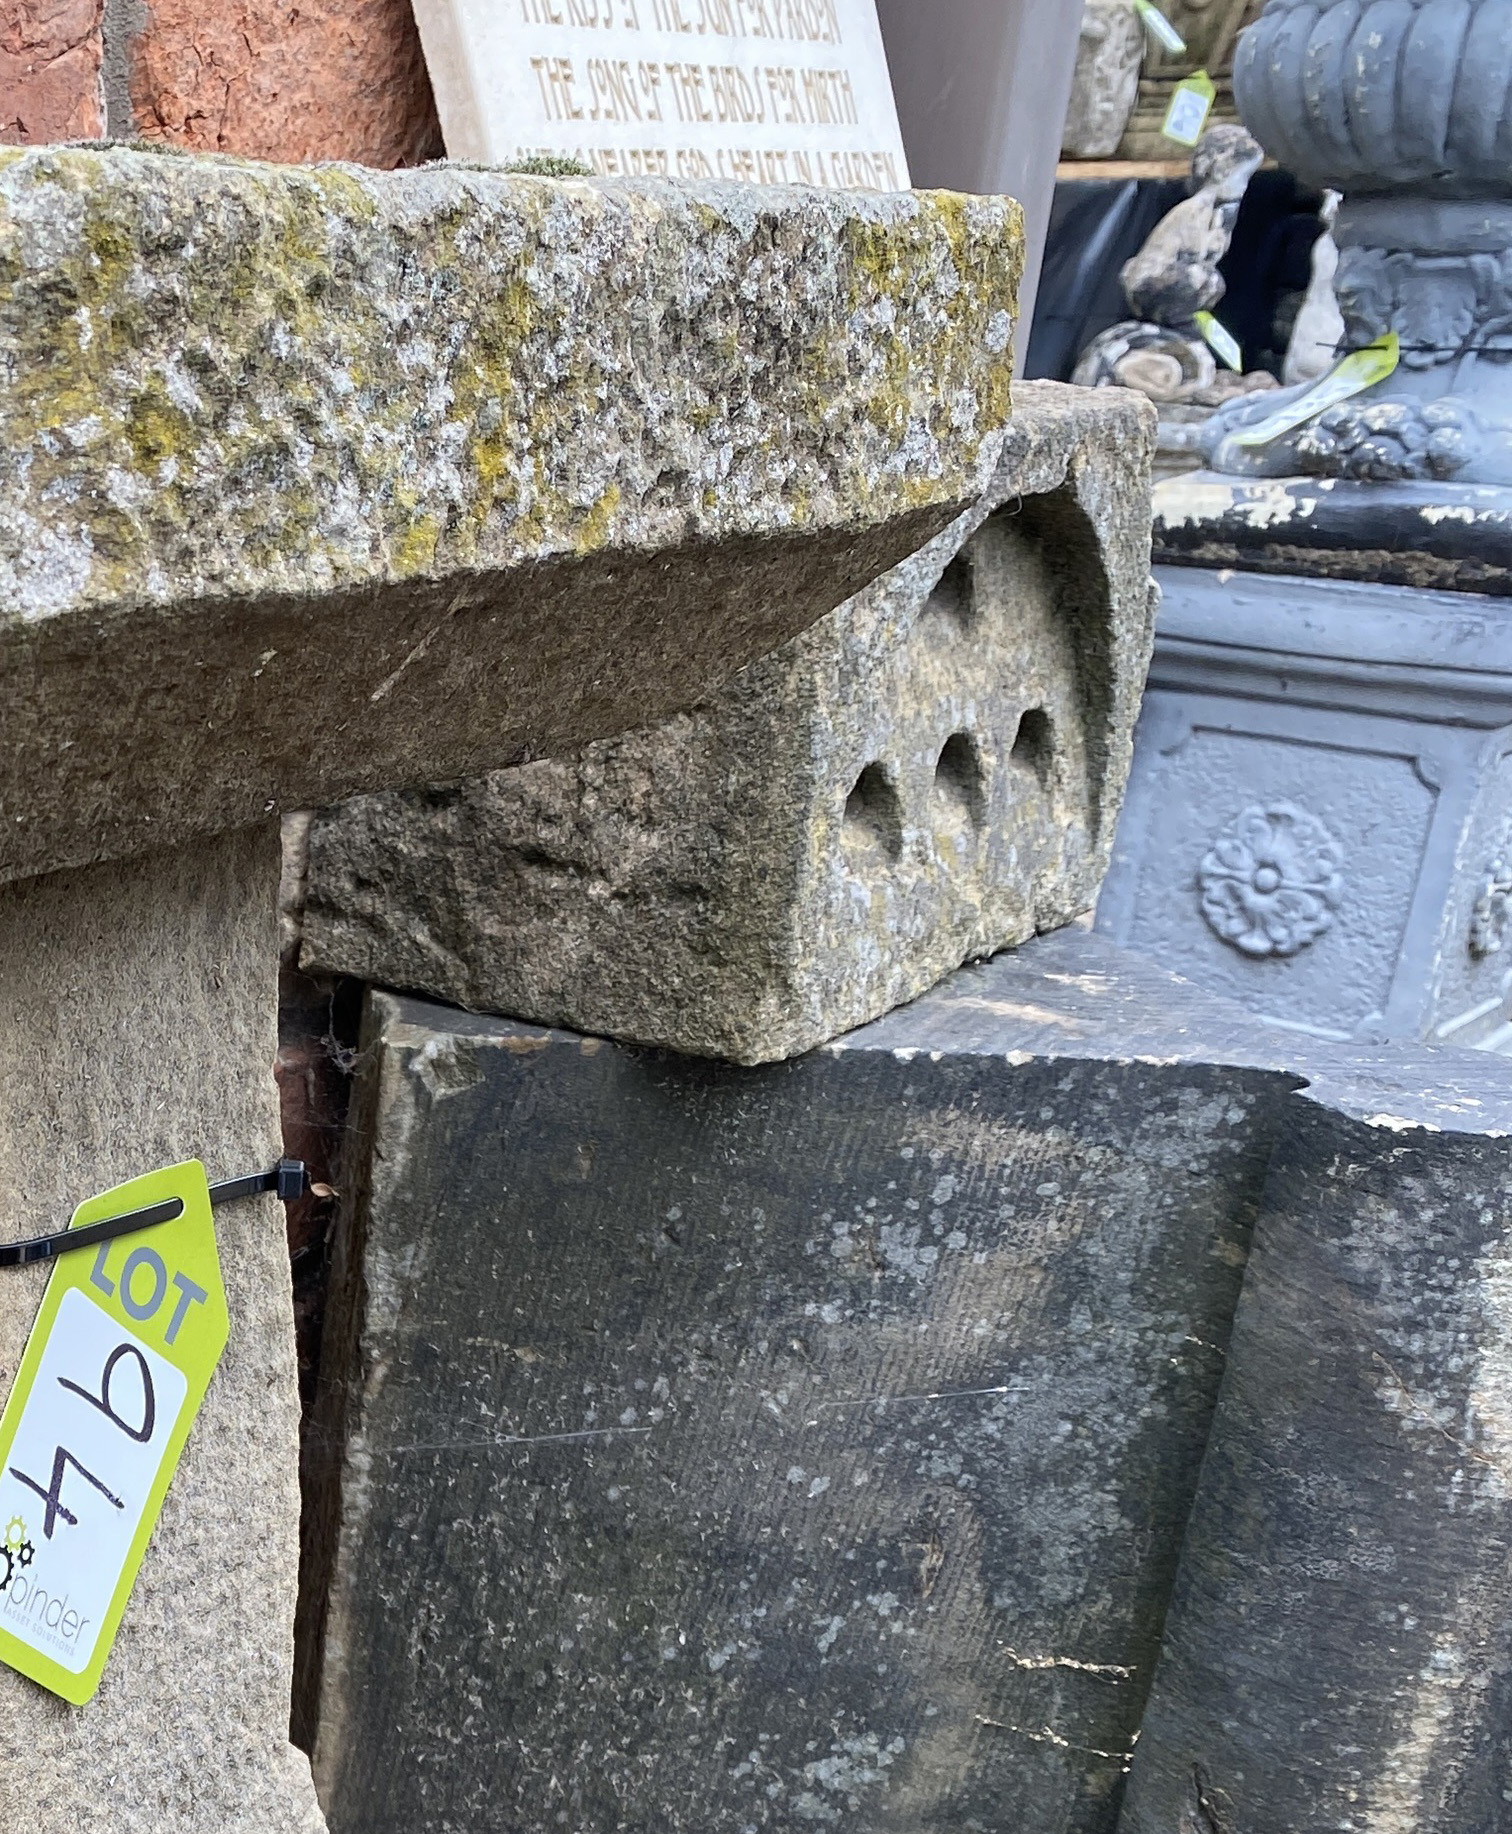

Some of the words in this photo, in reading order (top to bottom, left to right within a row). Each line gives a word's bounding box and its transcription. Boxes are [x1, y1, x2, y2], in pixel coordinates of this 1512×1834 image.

[529, 56, 585, 121] THE
[587, 58, 643, 121] SONG
[638, 60, 663, 121] OF
[664, 61, 713, 122] THE
[707, 65, 765, 124] BIRDS
[764, 66, 806, 124] FOR
[800, 67, 859, 125] MIRTH
[89, 1238, 208, 1346] LOT
[3, 1573, 91, 1644] pinder
[5, 1607, 30, 1627] ASSET
[32, 1622, 76, 1657] SOLUTIONS
